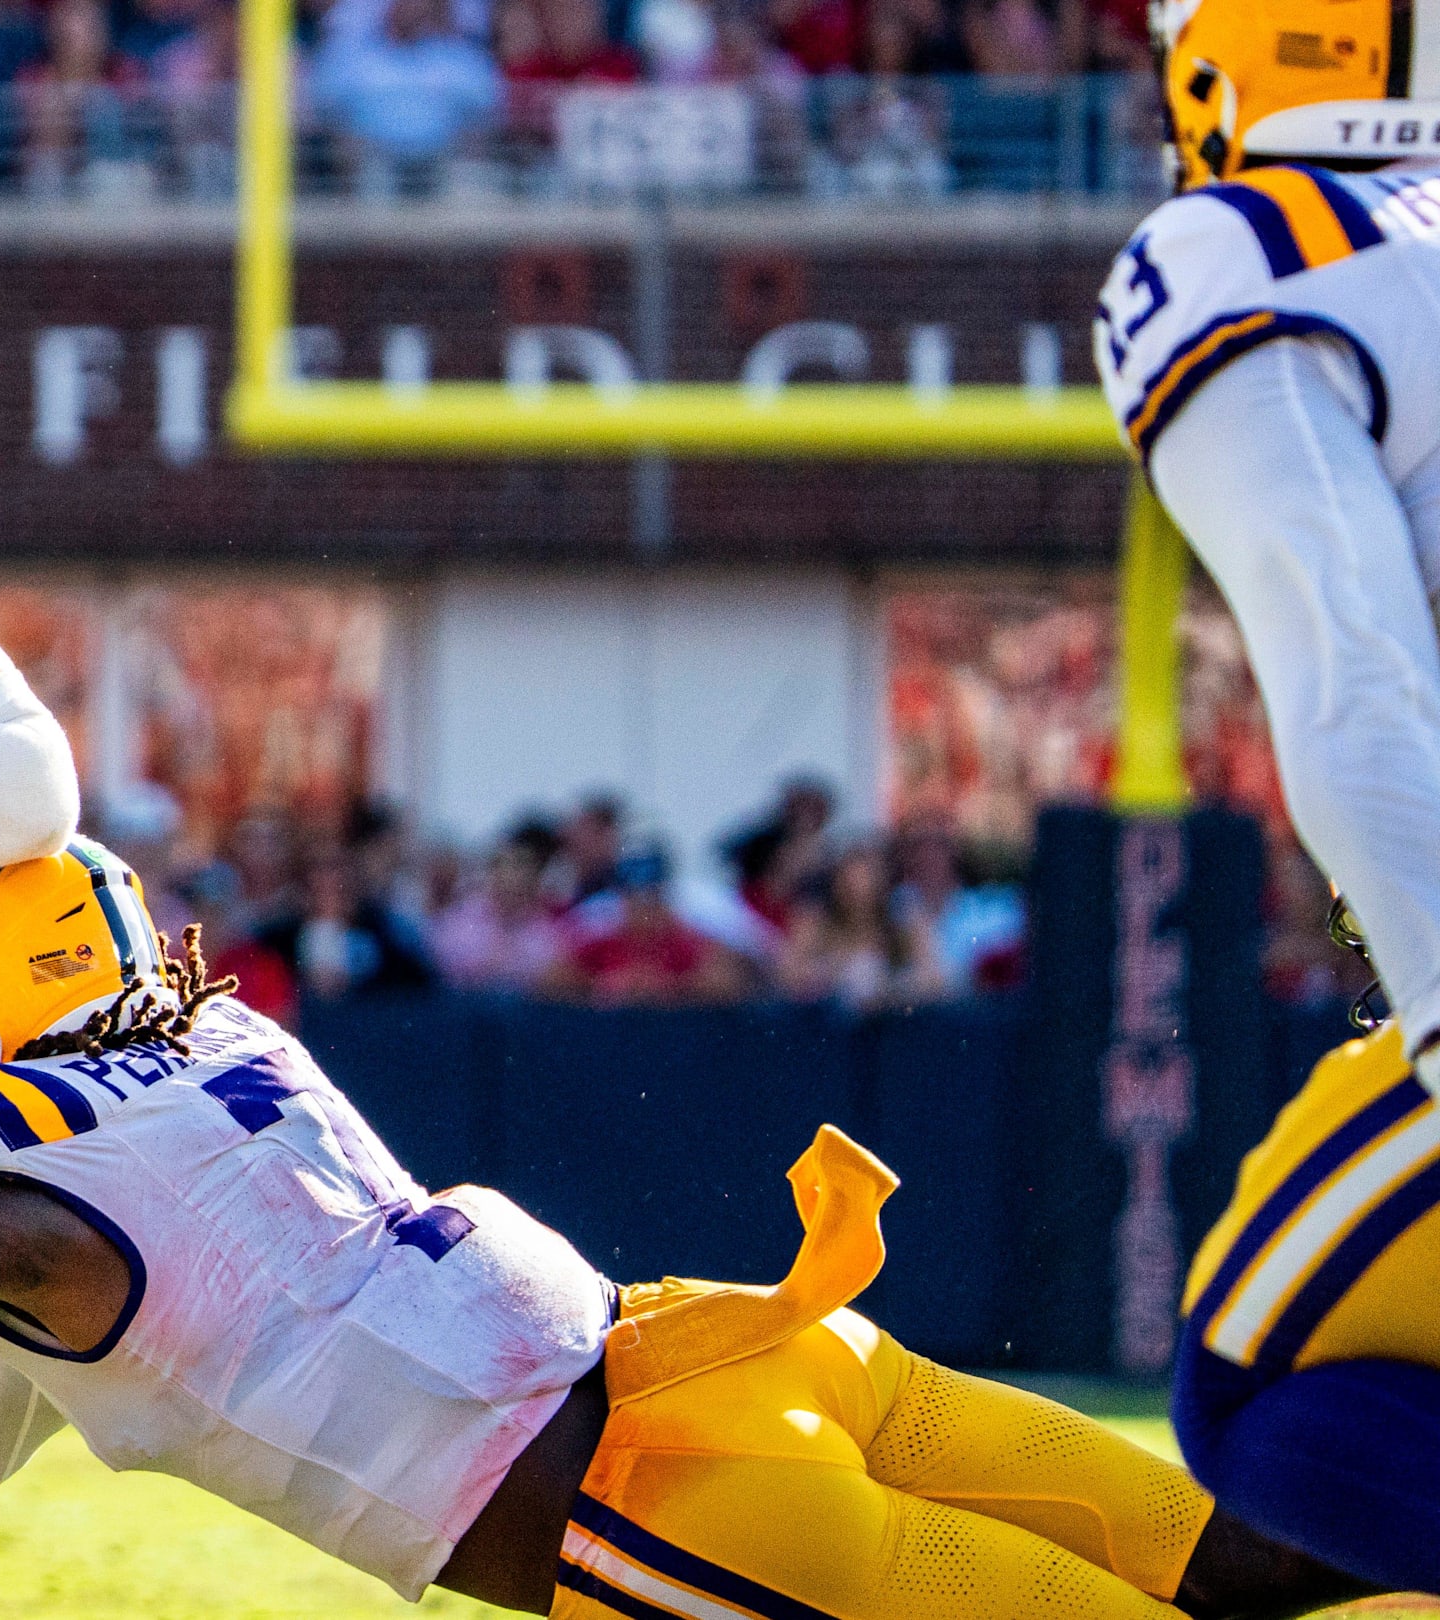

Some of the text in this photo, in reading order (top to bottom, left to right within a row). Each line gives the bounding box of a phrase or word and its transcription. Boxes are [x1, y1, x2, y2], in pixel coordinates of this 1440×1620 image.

[1337, 119, 1440, 144] TIG
[36, 949, 67, 962] DANGER
[201, 1047, 478, 1264] 7
